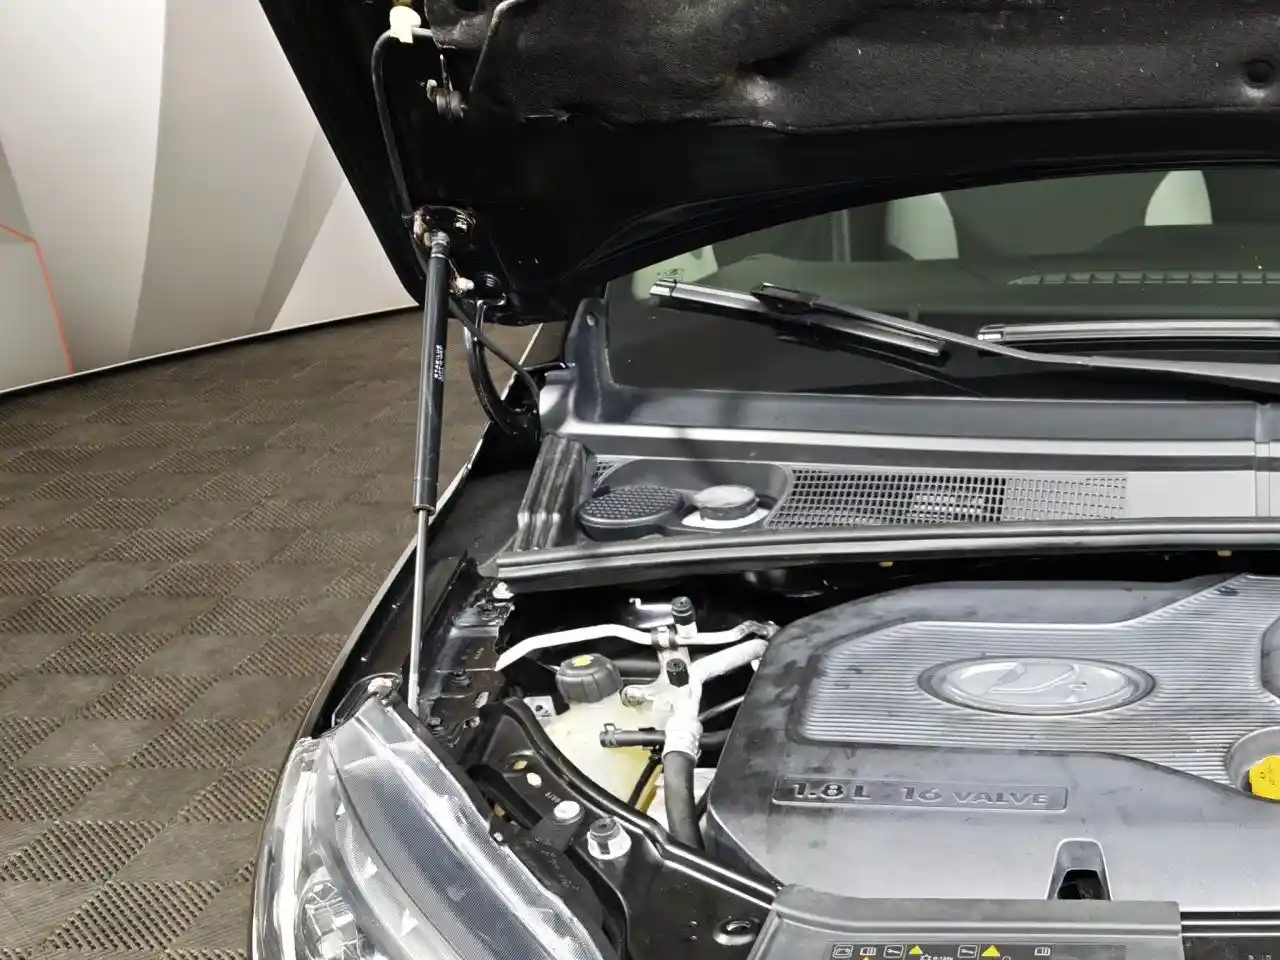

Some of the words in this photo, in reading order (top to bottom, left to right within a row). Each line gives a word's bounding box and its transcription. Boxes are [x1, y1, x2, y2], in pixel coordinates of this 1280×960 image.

[792, 782, 844, 800] 1.8
[851, 784, 871, 800] L
[900, 786, 942, 801] 16
[952, 790, 1049, 806] VALVE
